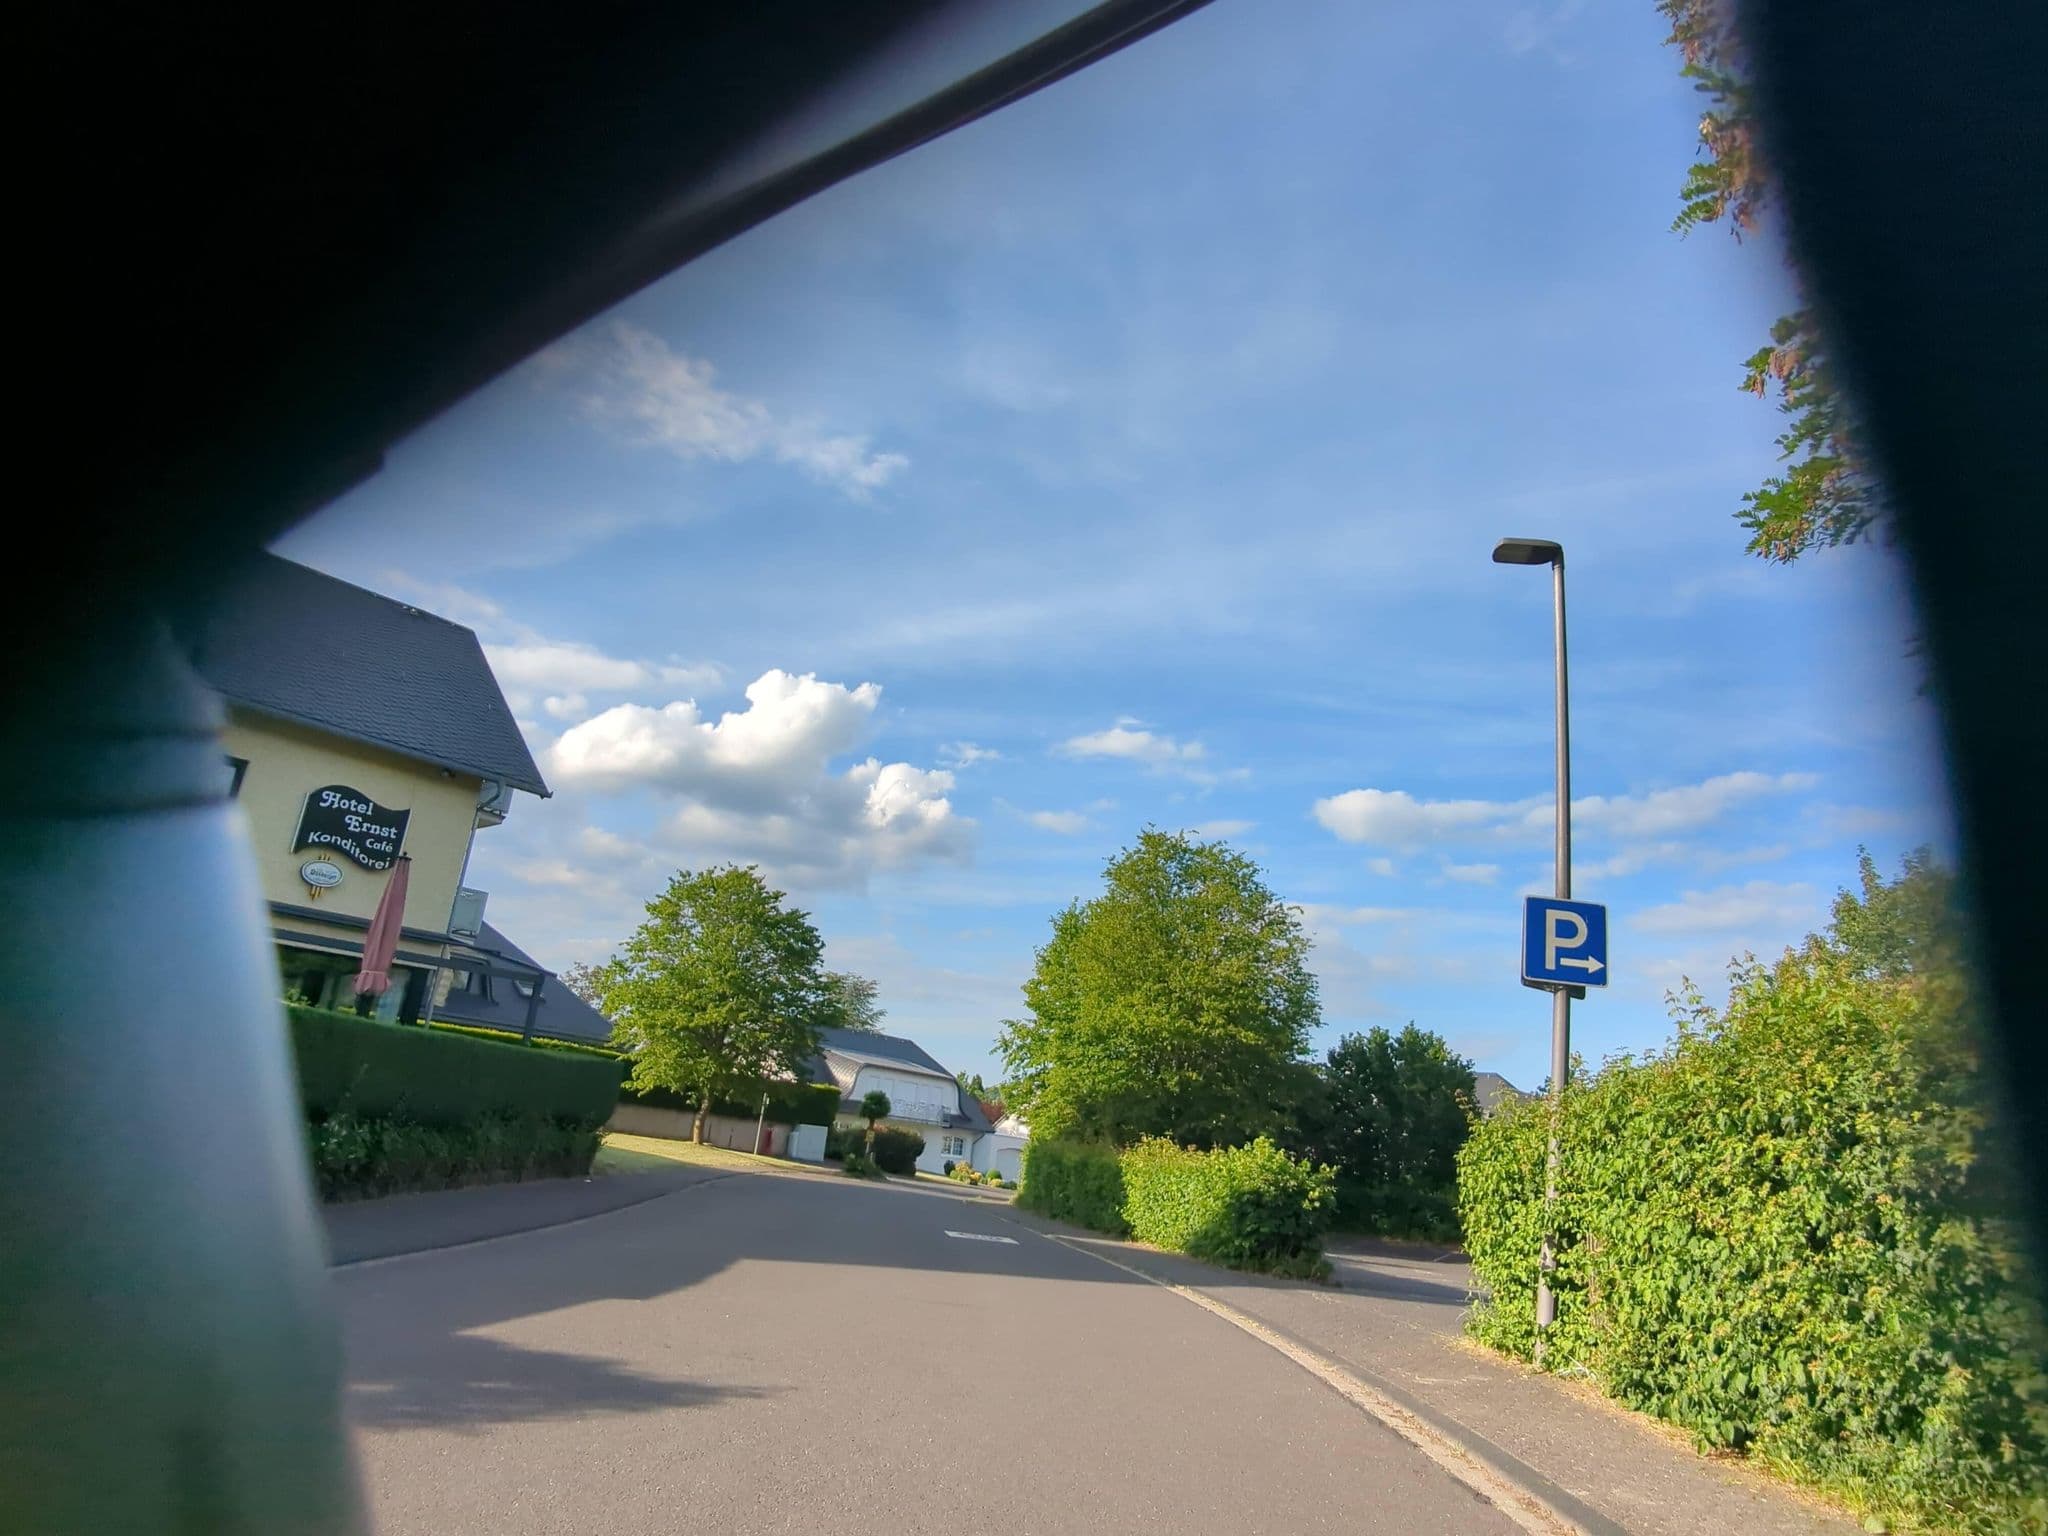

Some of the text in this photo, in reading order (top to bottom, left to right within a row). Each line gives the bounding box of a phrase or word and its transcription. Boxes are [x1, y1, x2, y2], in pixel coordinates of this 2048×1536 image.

[319, 790, 374, 816] Hotel
[344, 814, 398, 839] Ernst
[308, 831, 391, 870] Konditorei
[365, 838, 393, 853] Café
[1545, 908, 1588, 971] P
